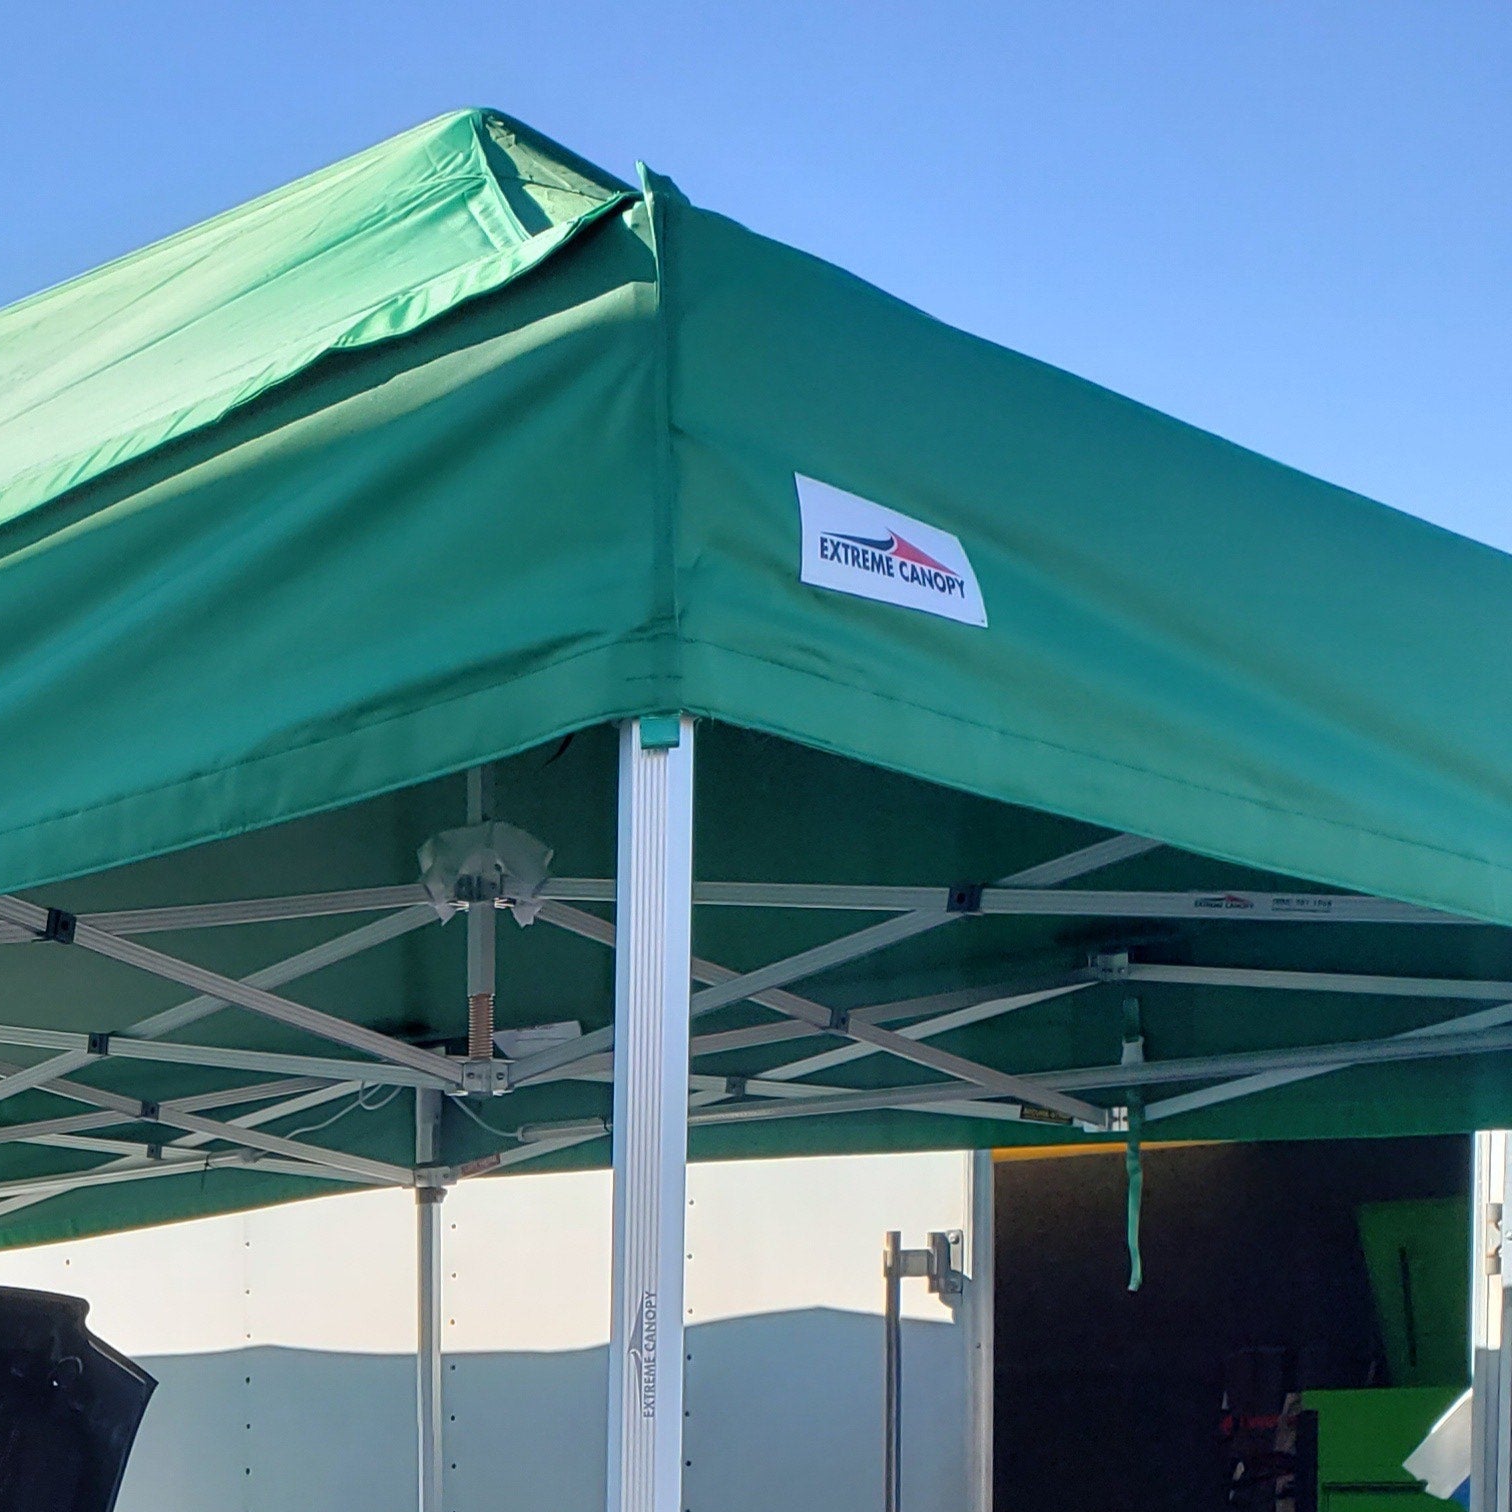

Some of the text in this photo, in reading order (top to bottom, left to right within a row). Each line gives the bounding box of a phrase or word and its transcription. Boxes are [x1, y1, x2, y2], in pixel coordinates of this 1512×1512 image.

[819, 536, 966, 599] EXTREME CANOPY
[643, 1290, 658, 1419] EXTREME CANOPY
